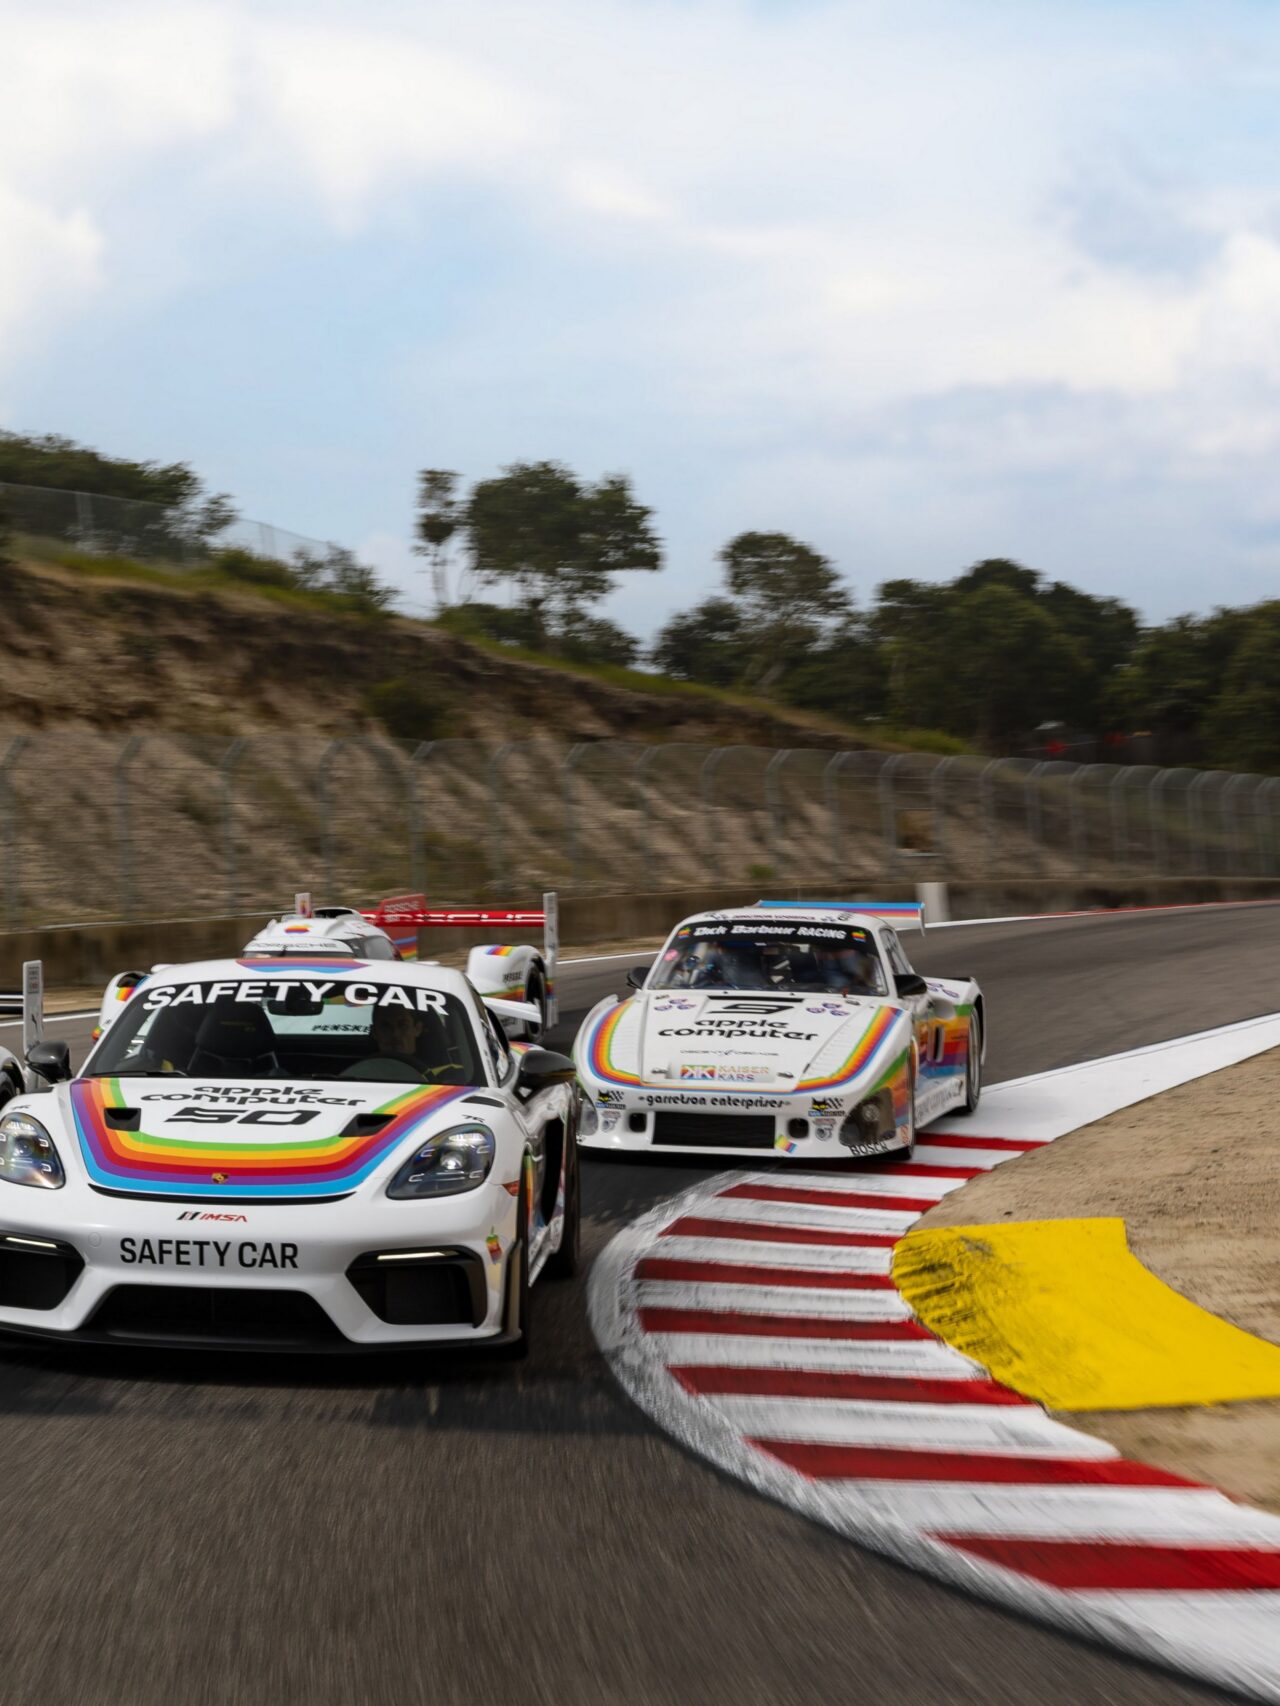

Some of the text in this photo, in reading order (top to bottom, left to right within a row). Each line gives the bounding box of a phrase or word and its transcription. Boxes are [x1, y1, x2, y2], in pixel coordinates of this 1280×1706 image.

[693, 925, 847, 940] Dick Barbour RACING
[142, 981, 450, 1016] SAFETY CAR
[694, 1018, 790, 1029] apple
[658, 1028, 818, 1044] computer
[719, 1065, 769, 1074] KAISER
[718, 1073, 756, 1081] KARS
[192, 1086, 325, 1097] apple
[140, 1093, 367, 1107] computer
[164, 1107, 322, 1126] 50
[198, 1213, 248, 1222] IMSA
[120, 1237, 299, 1269] SAFETY CAR
